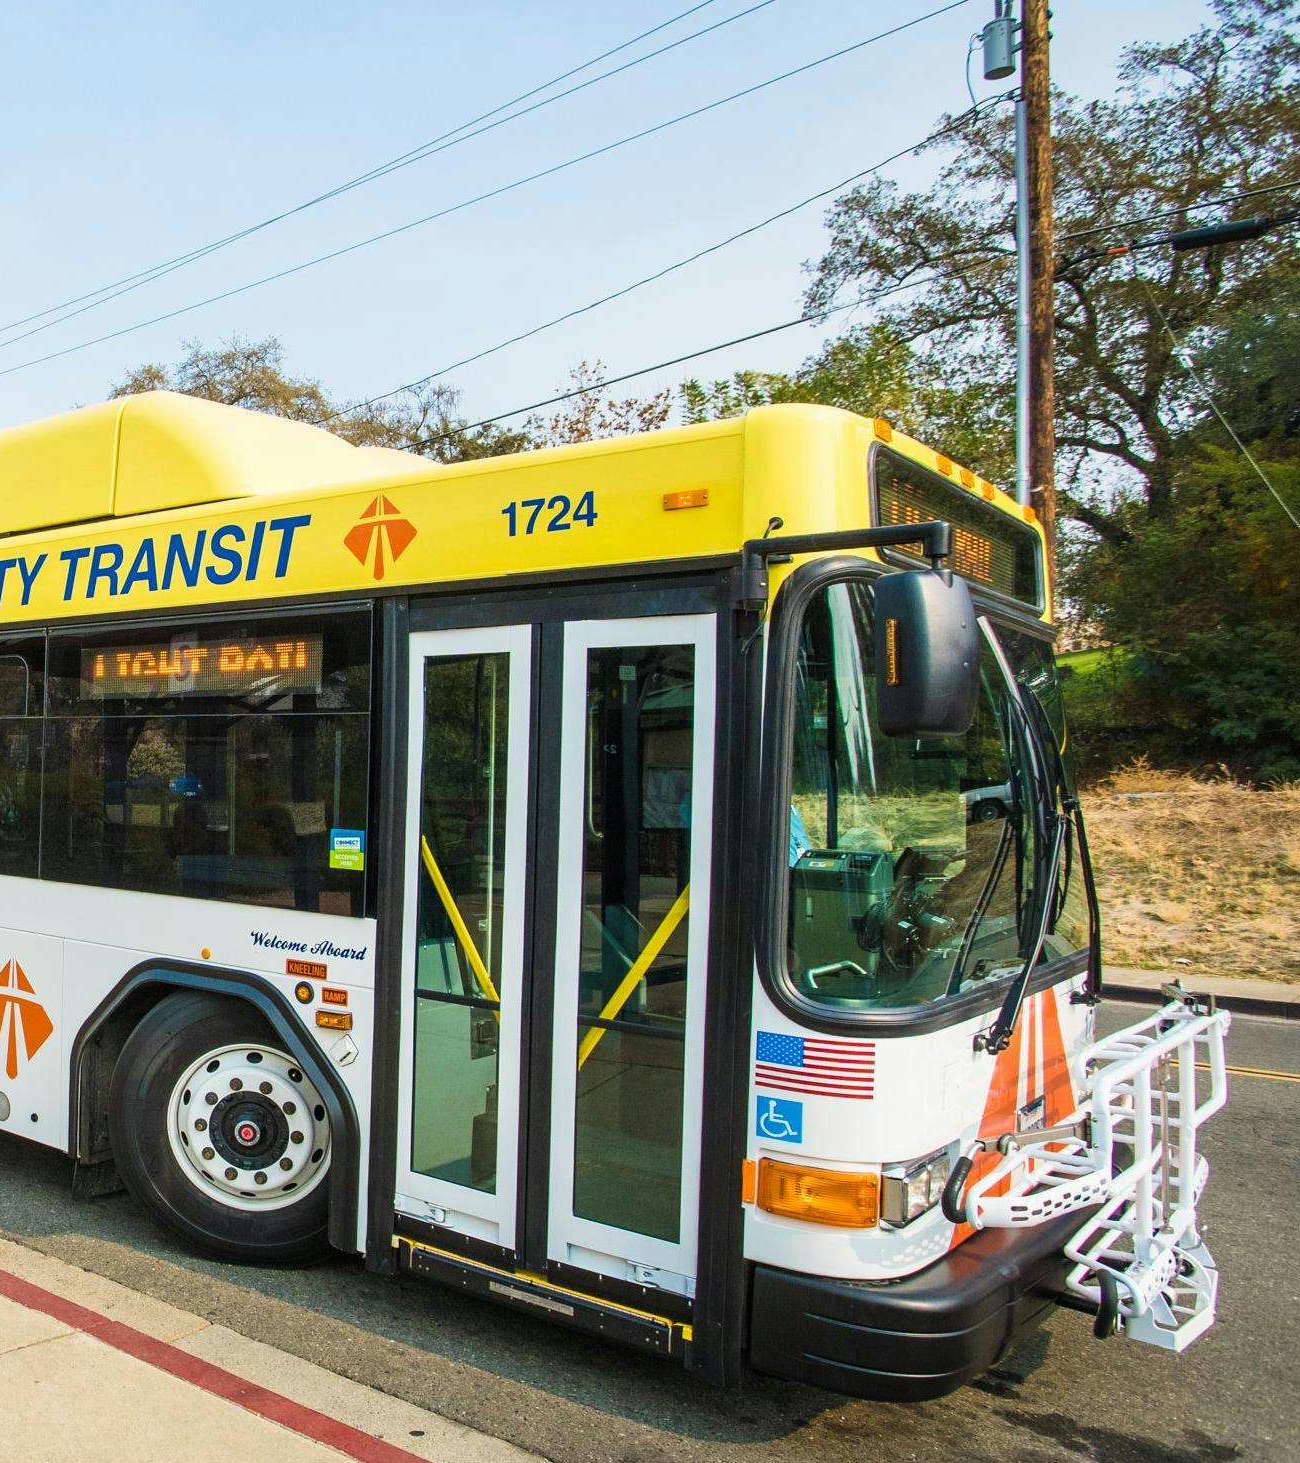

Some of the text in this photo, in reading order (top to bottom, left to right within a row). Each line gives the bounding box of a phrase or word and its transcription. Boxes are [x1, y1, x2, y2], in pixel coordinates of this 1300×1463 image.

[501, 490, 598, 537] 1724
[59, 514, 312, 601] TRANSIT
[335, 839, 359, 847] CONNECT
[250, 931, 367, 961] Welcome Aboard
[289, 961, 325, 977] KNEELING
[324, 991, 346, 1003] RAMP
